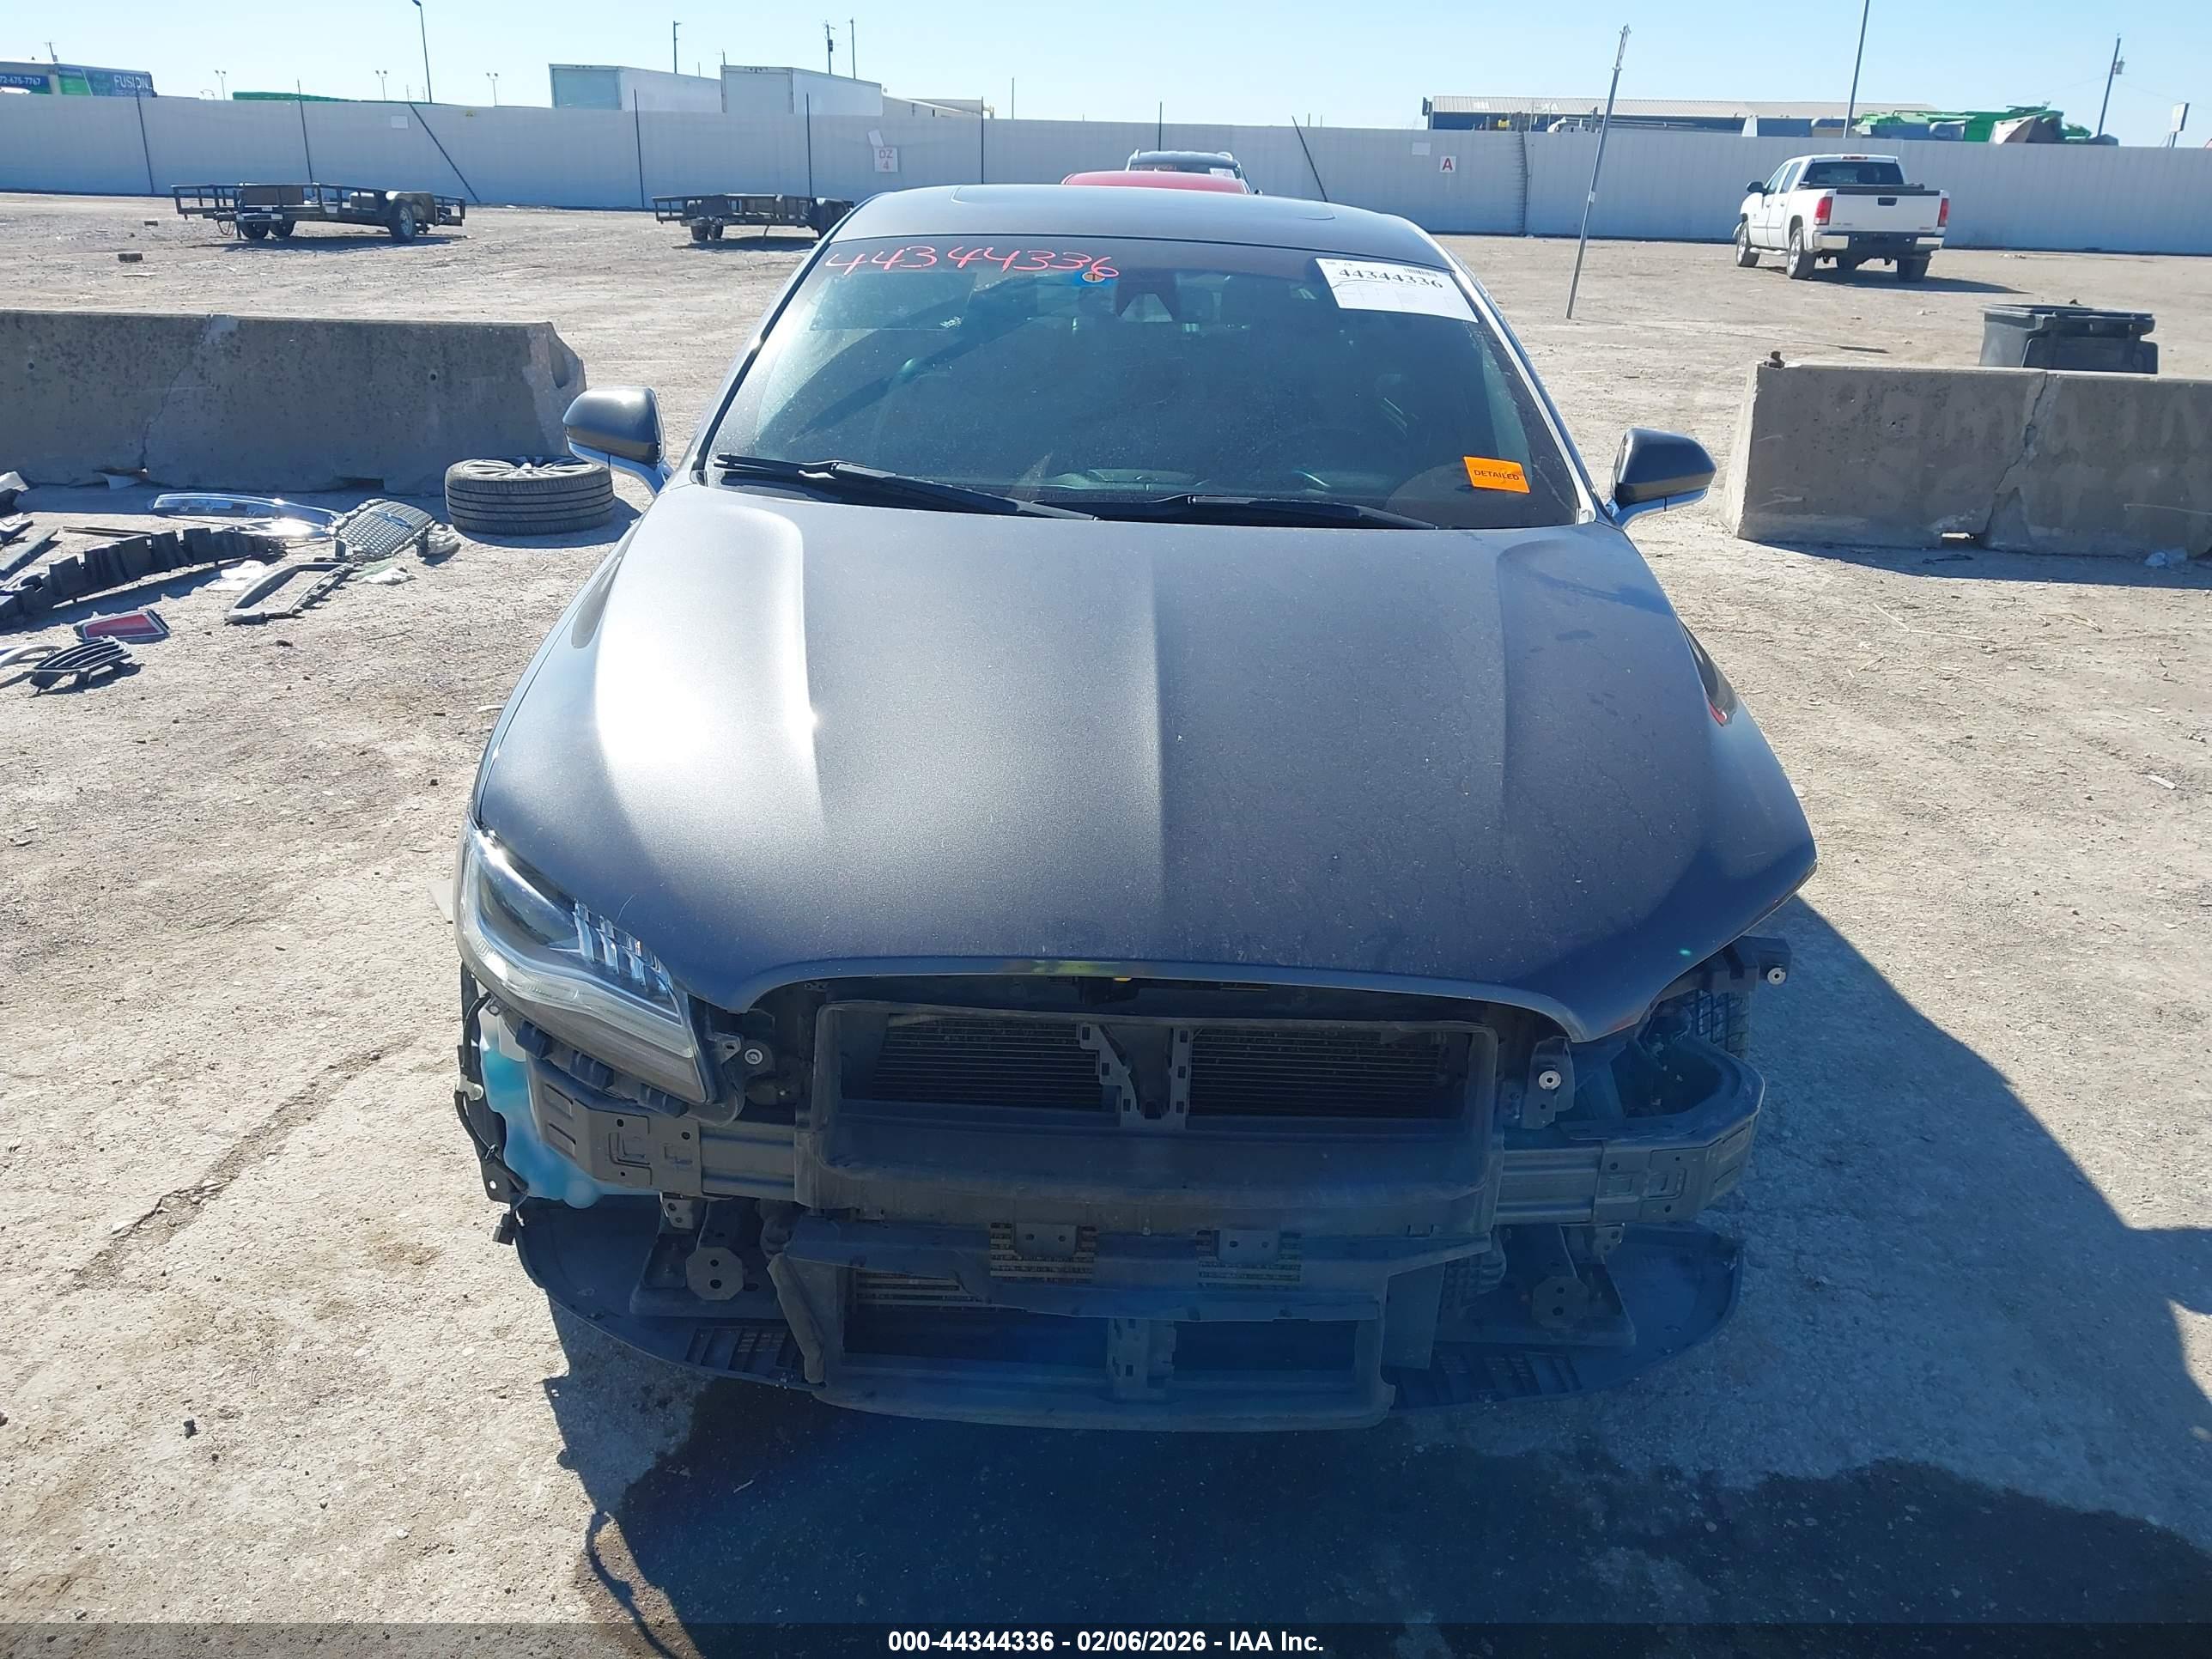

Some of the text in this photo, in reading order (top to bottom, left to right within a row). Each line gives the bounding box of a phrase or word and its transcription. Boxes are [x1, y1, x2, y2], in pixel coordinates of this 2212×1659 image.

[1442, 157, 1453, 171] A
[1339, 269, 1443, 289] 44344336
[1474, 469, 1520, 481] DETAILED
